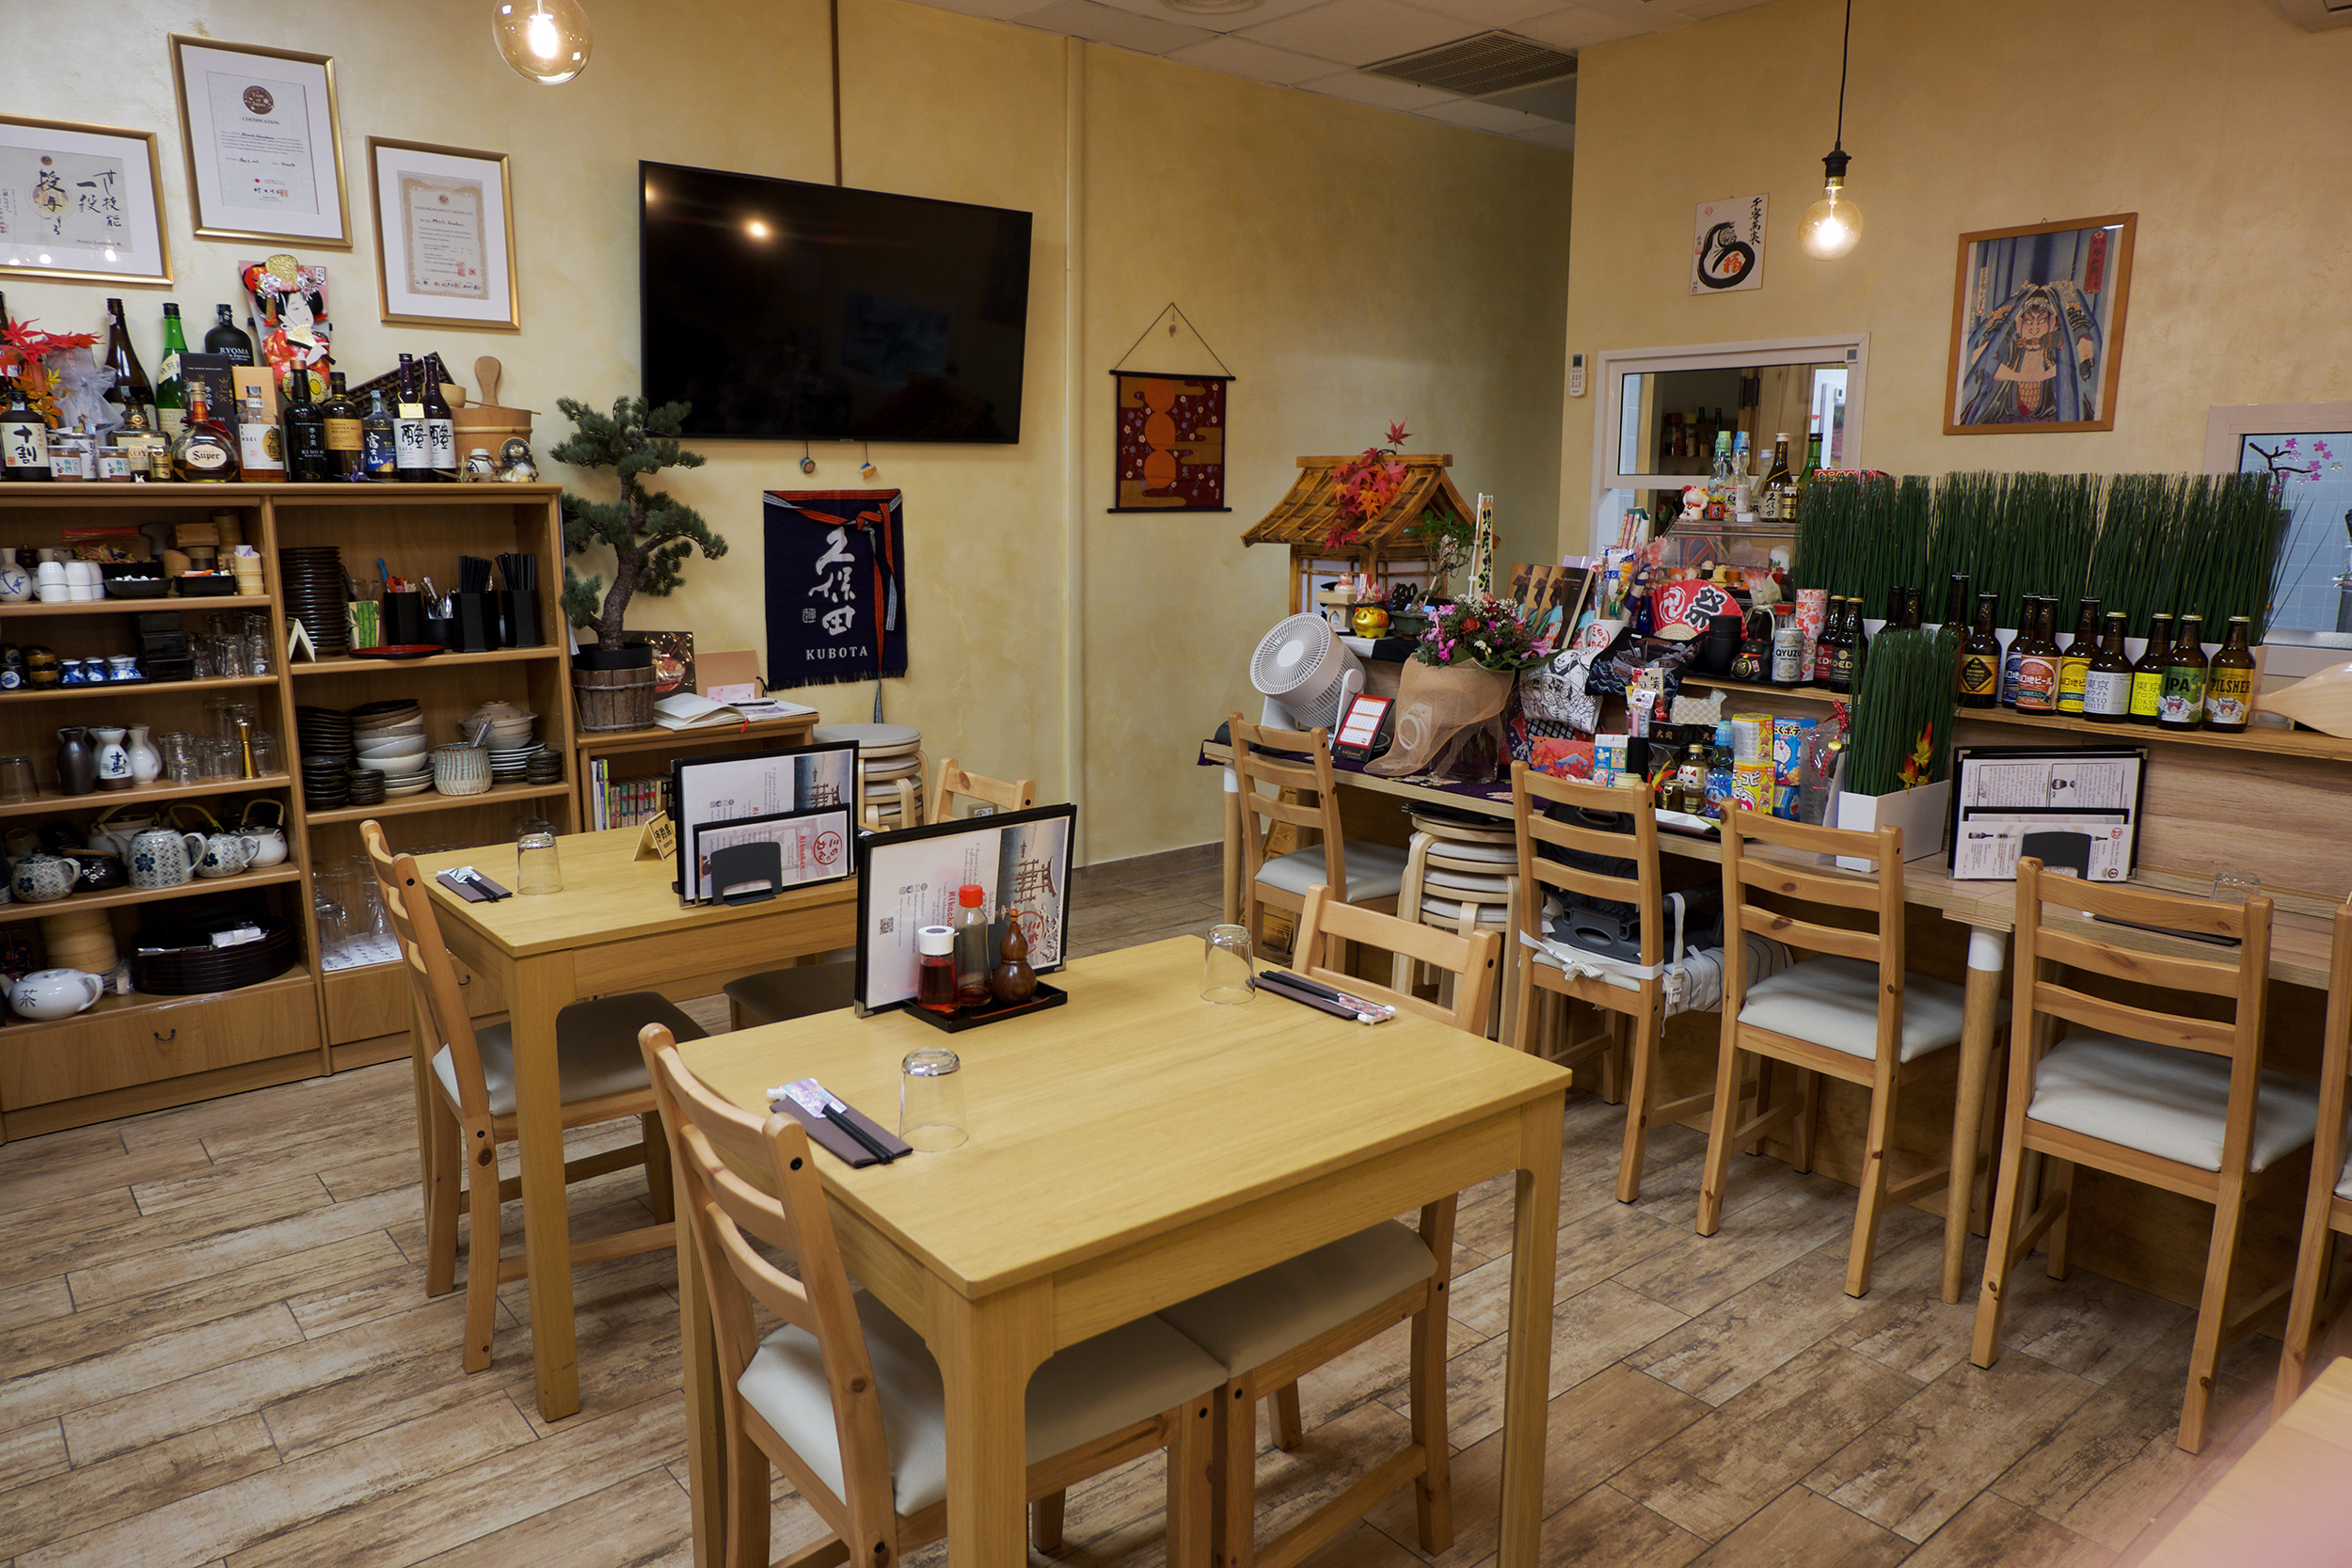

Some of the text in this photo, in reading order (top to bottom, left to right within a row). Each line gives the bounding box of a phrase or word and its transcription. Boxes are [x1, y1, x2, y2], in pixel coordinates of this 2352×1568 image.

[219, 346, 249, 356] RYOMA
[192, 450, 220, 462] Super
[808, 526, 856, 636] 久保田
[806, 645, 868, 660] KUBOTA
[2088, 679, 2109, 690] 東京
[2137, 681, 2160, 692] 東京
[2165, 677, 2190, 692] IPA
[2210, 678, 2250, 693] PILSNER
[946, 891, 957, 927] Mikacha
[19, 990, 37, 1009] 茶
